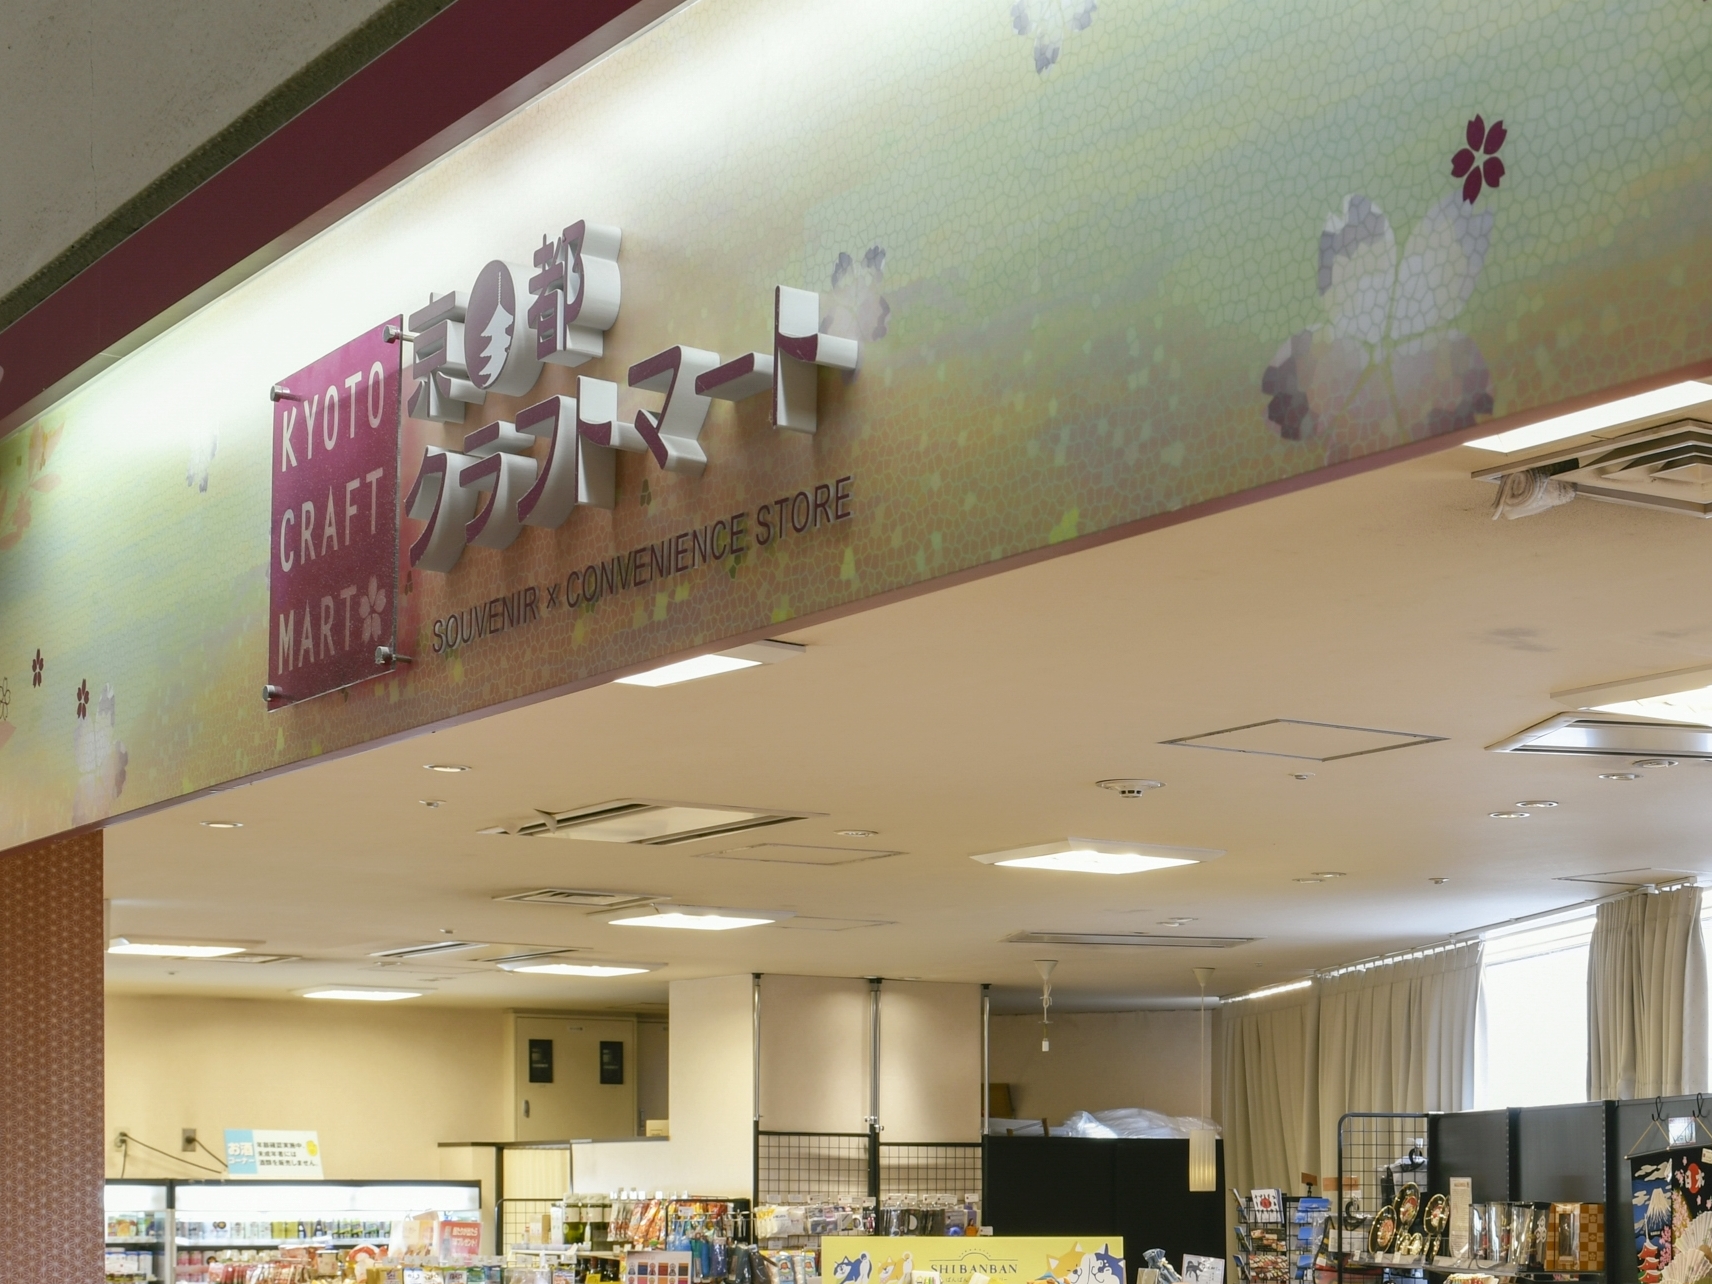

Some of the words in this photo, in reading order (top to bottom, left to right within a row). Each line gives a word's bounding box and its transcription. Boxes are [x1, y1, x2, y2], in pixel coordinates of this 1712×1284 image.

[281, 361, 384, 472] KYOTO
[404, 285, 859, 573] クラフトマート
[280, 467, 383, 572] CRAFT
[432, 585, 540, 654] SOUVENIR
[565, 511, 748, 610] CONVENIENCE
[755, 475, 853, 546] STORE
[278, 585, 357, 675] MART
[228, 1142, 254, 1156] お酒
[930, 1263, 1018, 1274] SHIBANBAN
